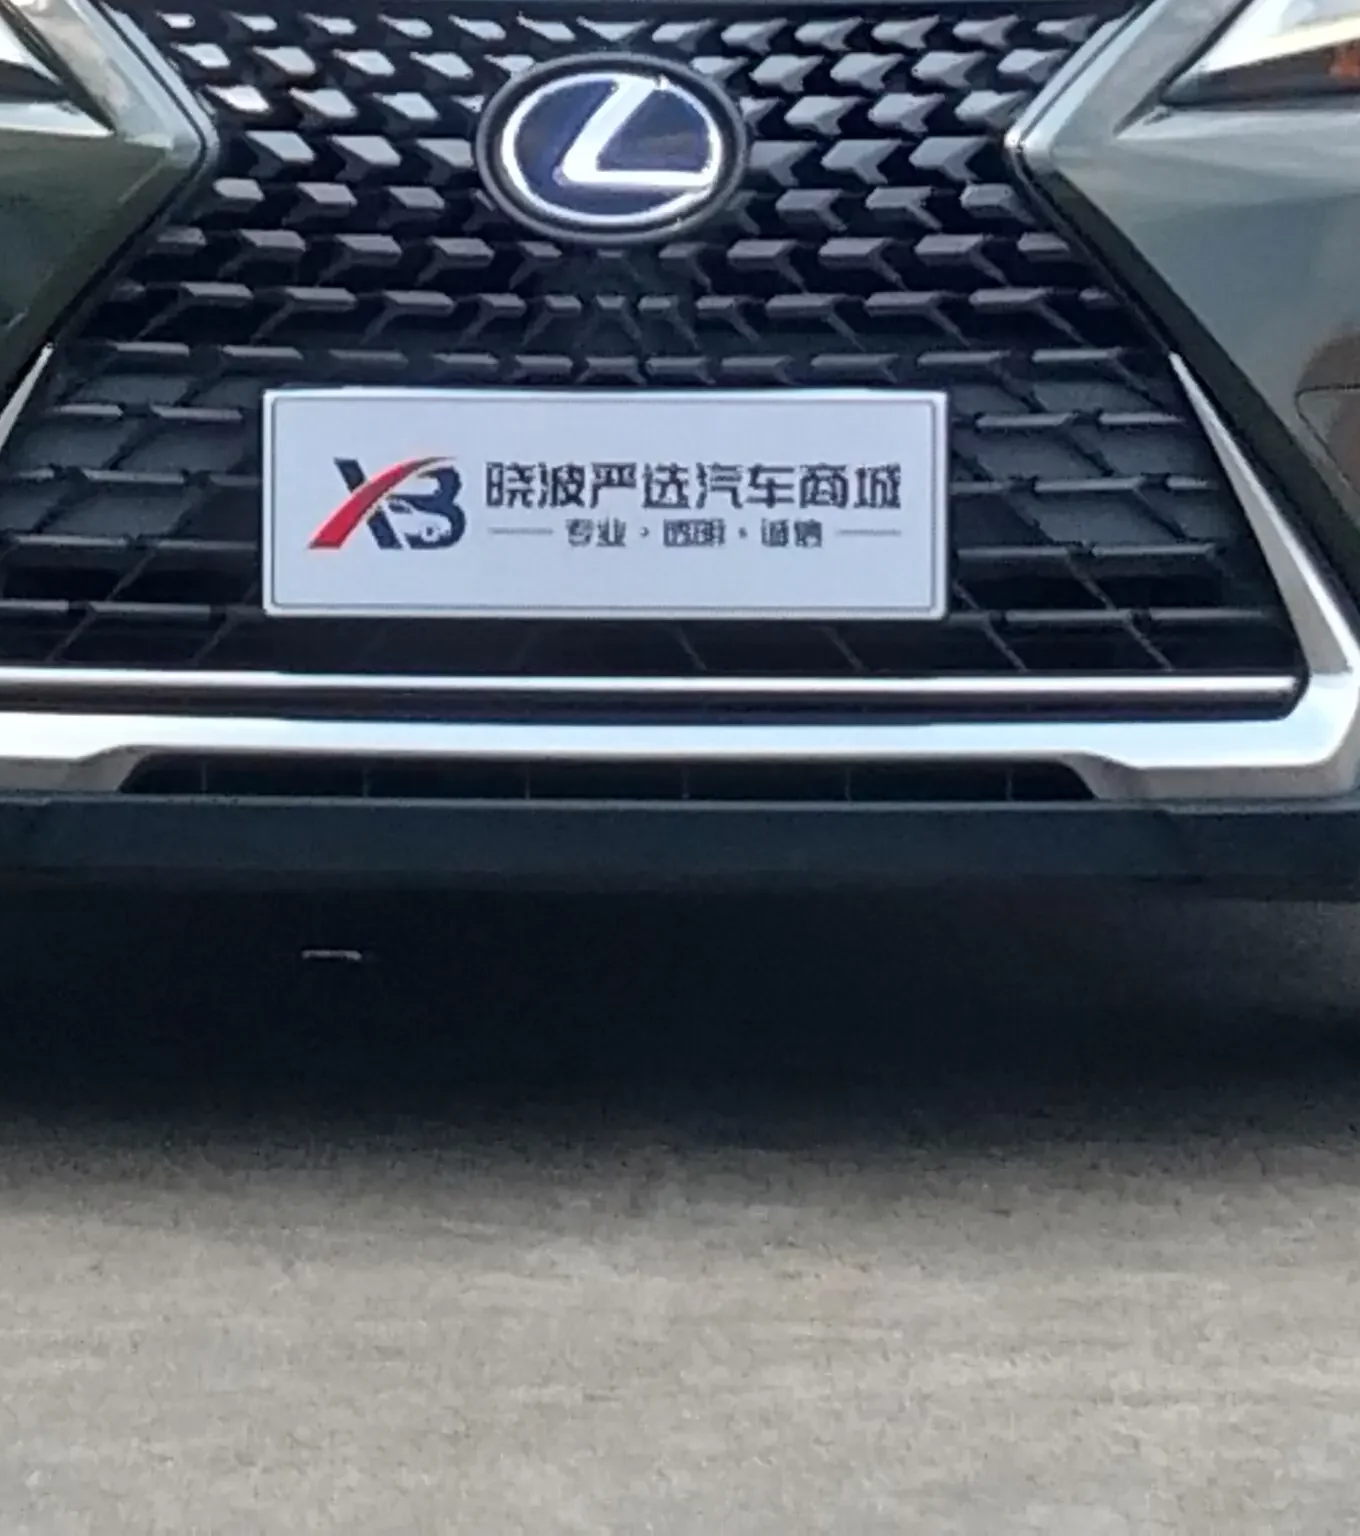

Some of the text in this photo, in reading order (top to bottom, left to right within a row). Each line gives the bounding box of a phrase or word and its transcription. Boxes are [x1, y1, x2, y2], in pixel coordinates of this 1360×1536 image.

[486, 462, 901, 509] 晓波严选汽车商城
